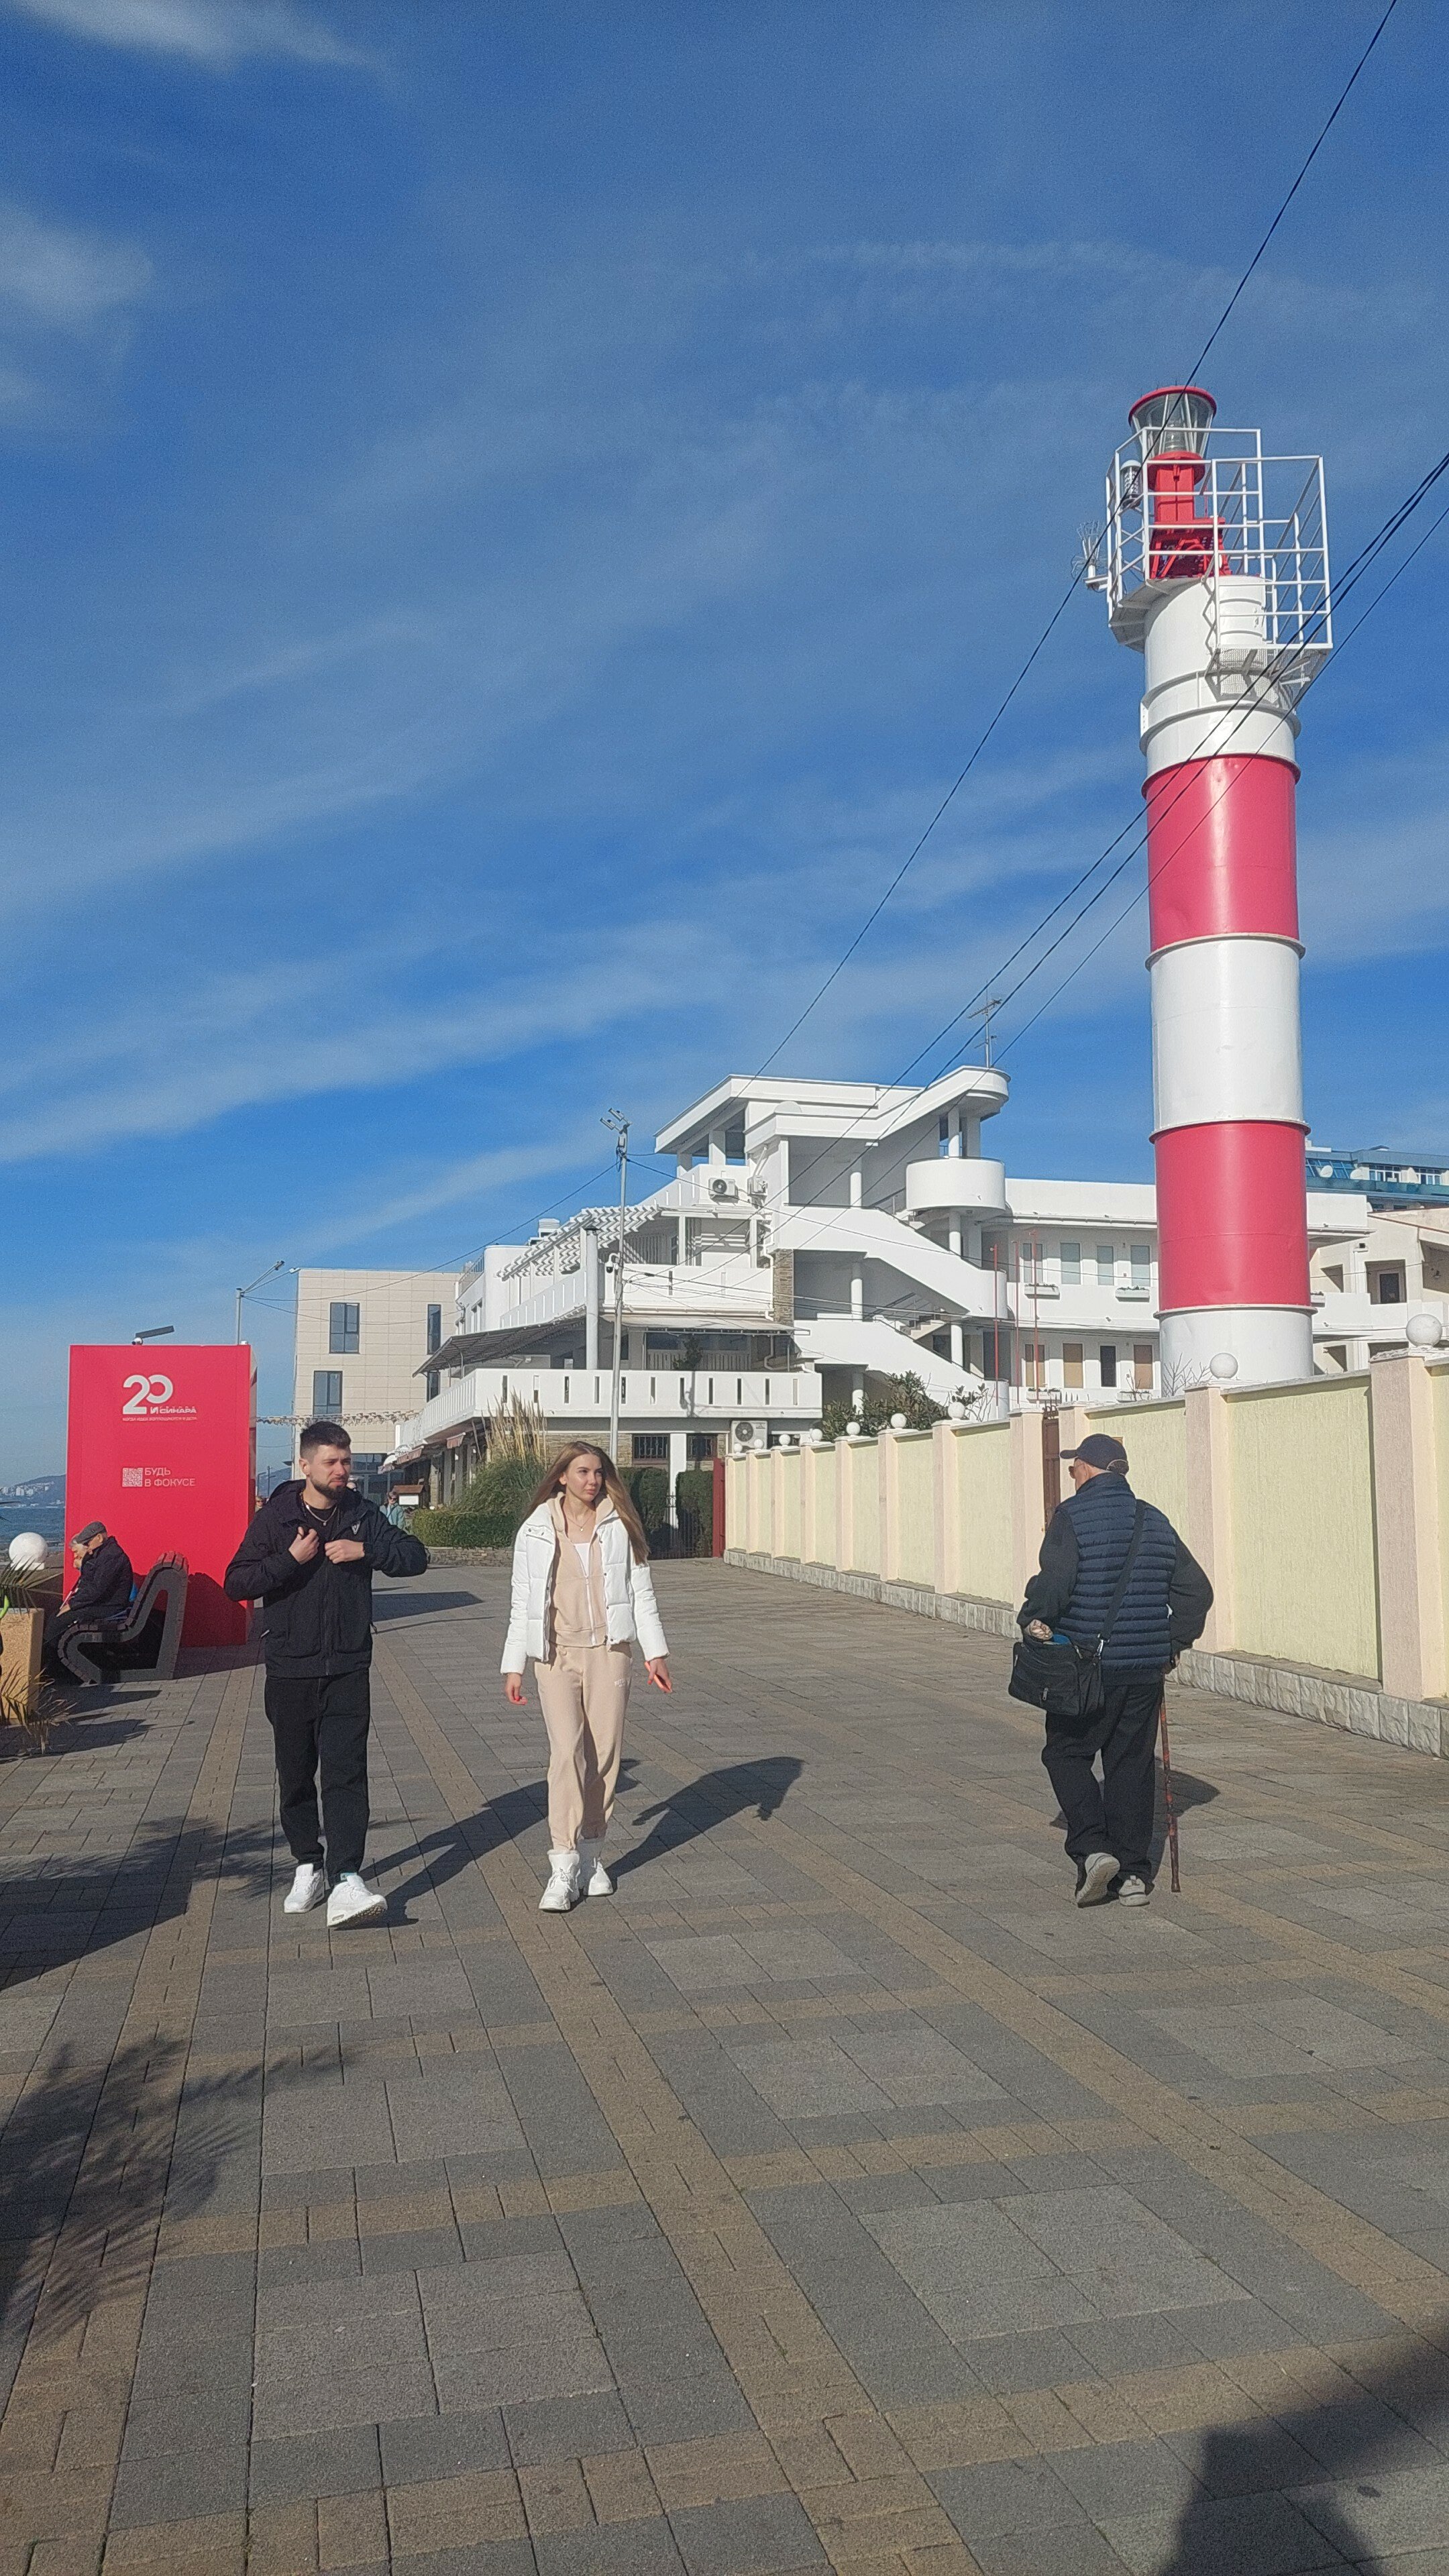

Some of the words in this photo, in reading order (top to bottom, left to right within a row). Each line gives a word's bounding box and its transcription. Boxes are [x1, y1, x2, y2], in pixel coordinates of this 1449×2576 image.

[123, 1375, 173, 1415] 20
[144, 1467, 171, 1477] БУДЬ
[144, 1479, 152, 1487] В
[154, 1479, 196, 1487] ФОКУСЕ
